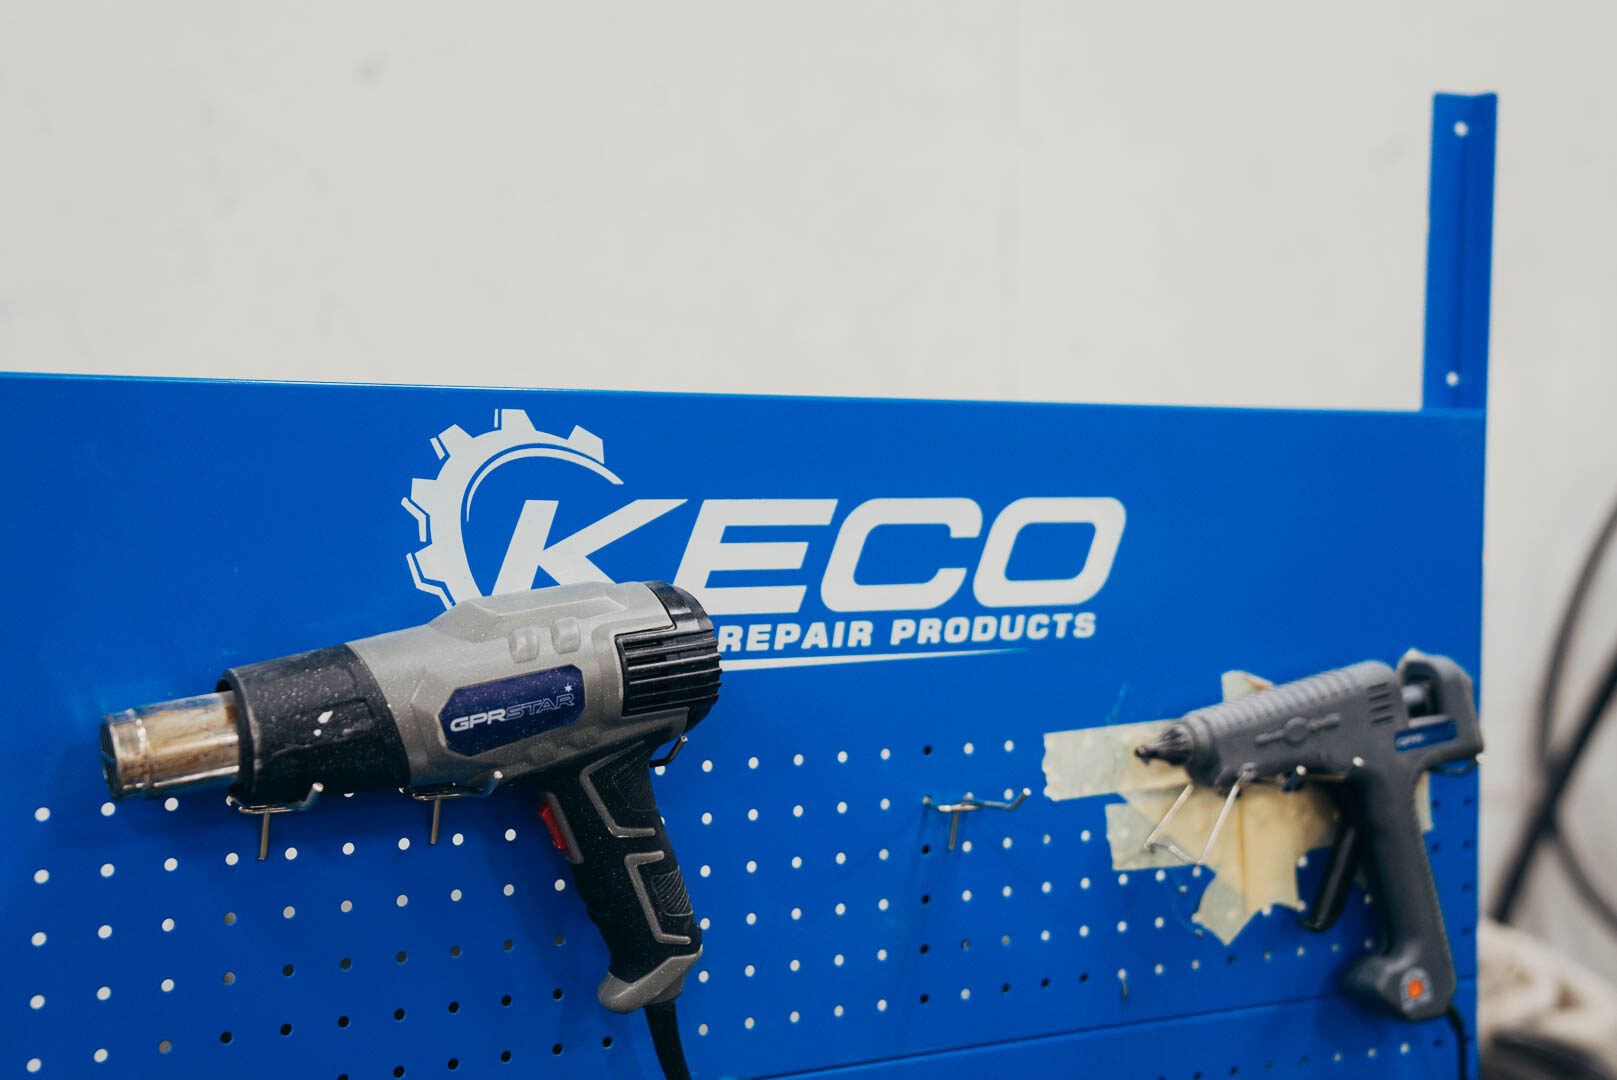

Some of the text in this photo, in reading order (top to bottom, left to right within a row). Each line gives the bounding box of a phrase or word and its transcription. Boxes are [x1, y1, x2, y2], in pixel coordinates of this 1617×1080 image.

[491, 497, 1128, 615] KECO
[717, 612, 1097, 653] REPAIR PRODUCTS
